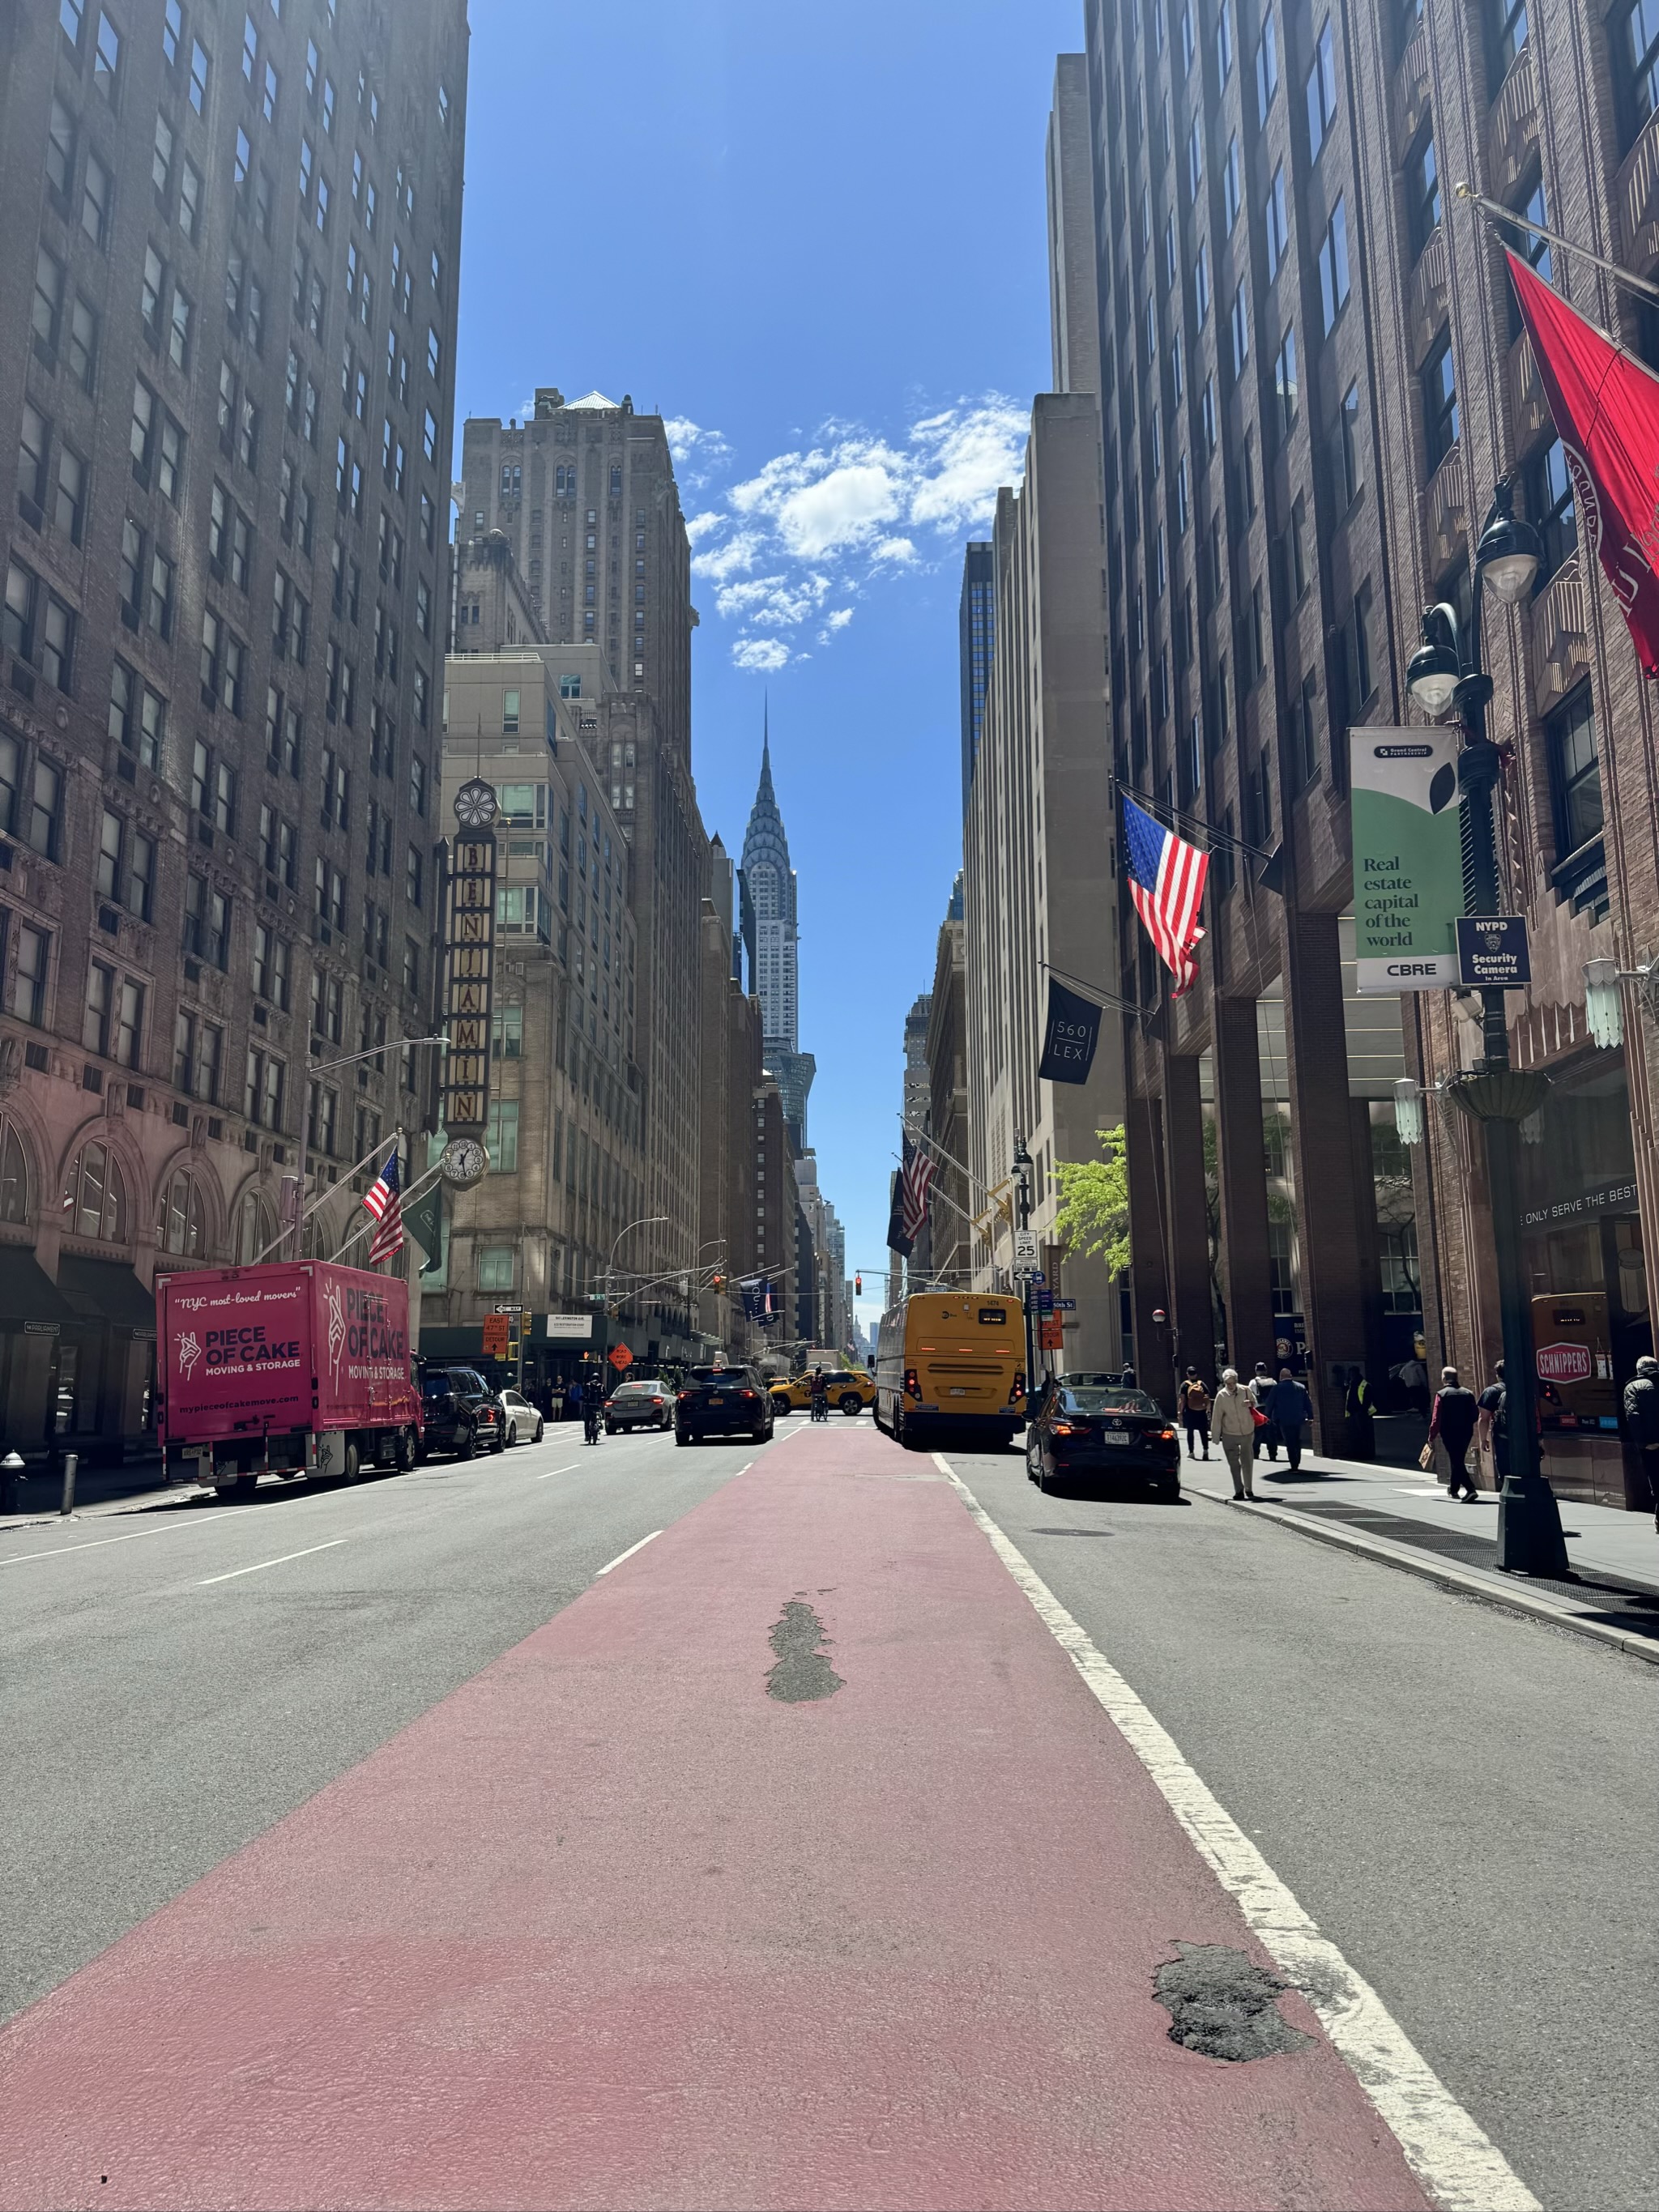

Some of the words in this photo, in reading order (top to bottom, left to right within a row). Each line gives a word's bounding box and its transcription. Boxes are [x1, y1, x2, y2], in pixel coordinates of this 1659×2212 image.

[1364, 857, 1399, 872] Real
[1364, 877, 1411, 890] estate
[1365, 893, 1419, 912] capital
[1366, 914, 1384, 927] of
[1384, 914, 1410, 927] the
[1476, 922, 1508, 931] NYPD
[1367, 932, 1413, 946] world
[1472, 953, 1516, 965] Security
[1387, 964, 1436, 976] CBRE
[1474, 965, 1517, 974] Camera
[457, 847, 479, 1116] BENJAMIN
[1057, 1021, 1085, 1037] 560
[1054, 1044, 1082, 1060] LEX
[1525, 1208, 1548, 1224] ONLY
[1551, 1200, 1582, 1217] SERVE
[1585, 1193, 1605, 1208] THE
[1610, 1184, 1637, 1202] BEST
[1017, 1246, 1034, 1255] 25
[210, 1290, 261, 1306] most-loved
[347, 1288, 384, 1323] PIECE
[206, 1326, 266, 1347] PIECE
[348, 1325, 369, 1357] OF
[371, 1328, 403, 1359] CAKE
[206, 1348, 235, 1365] OF
[240, 1341, 300, 1362] CAKE
[206, 1365, 244, 1376] MOVING
[256, 1359, 301, 1370] STORAGE
[1539, 1352, 1588, 1374] SCHNIPPERS
[349, 1365, 373, 1379] MOVING
[374, 1369, 378, 1379] &
[379, 1366, 404, 1379] STORAGE
[180, 1396, 298, 1413] mypieceofcakemove.com
